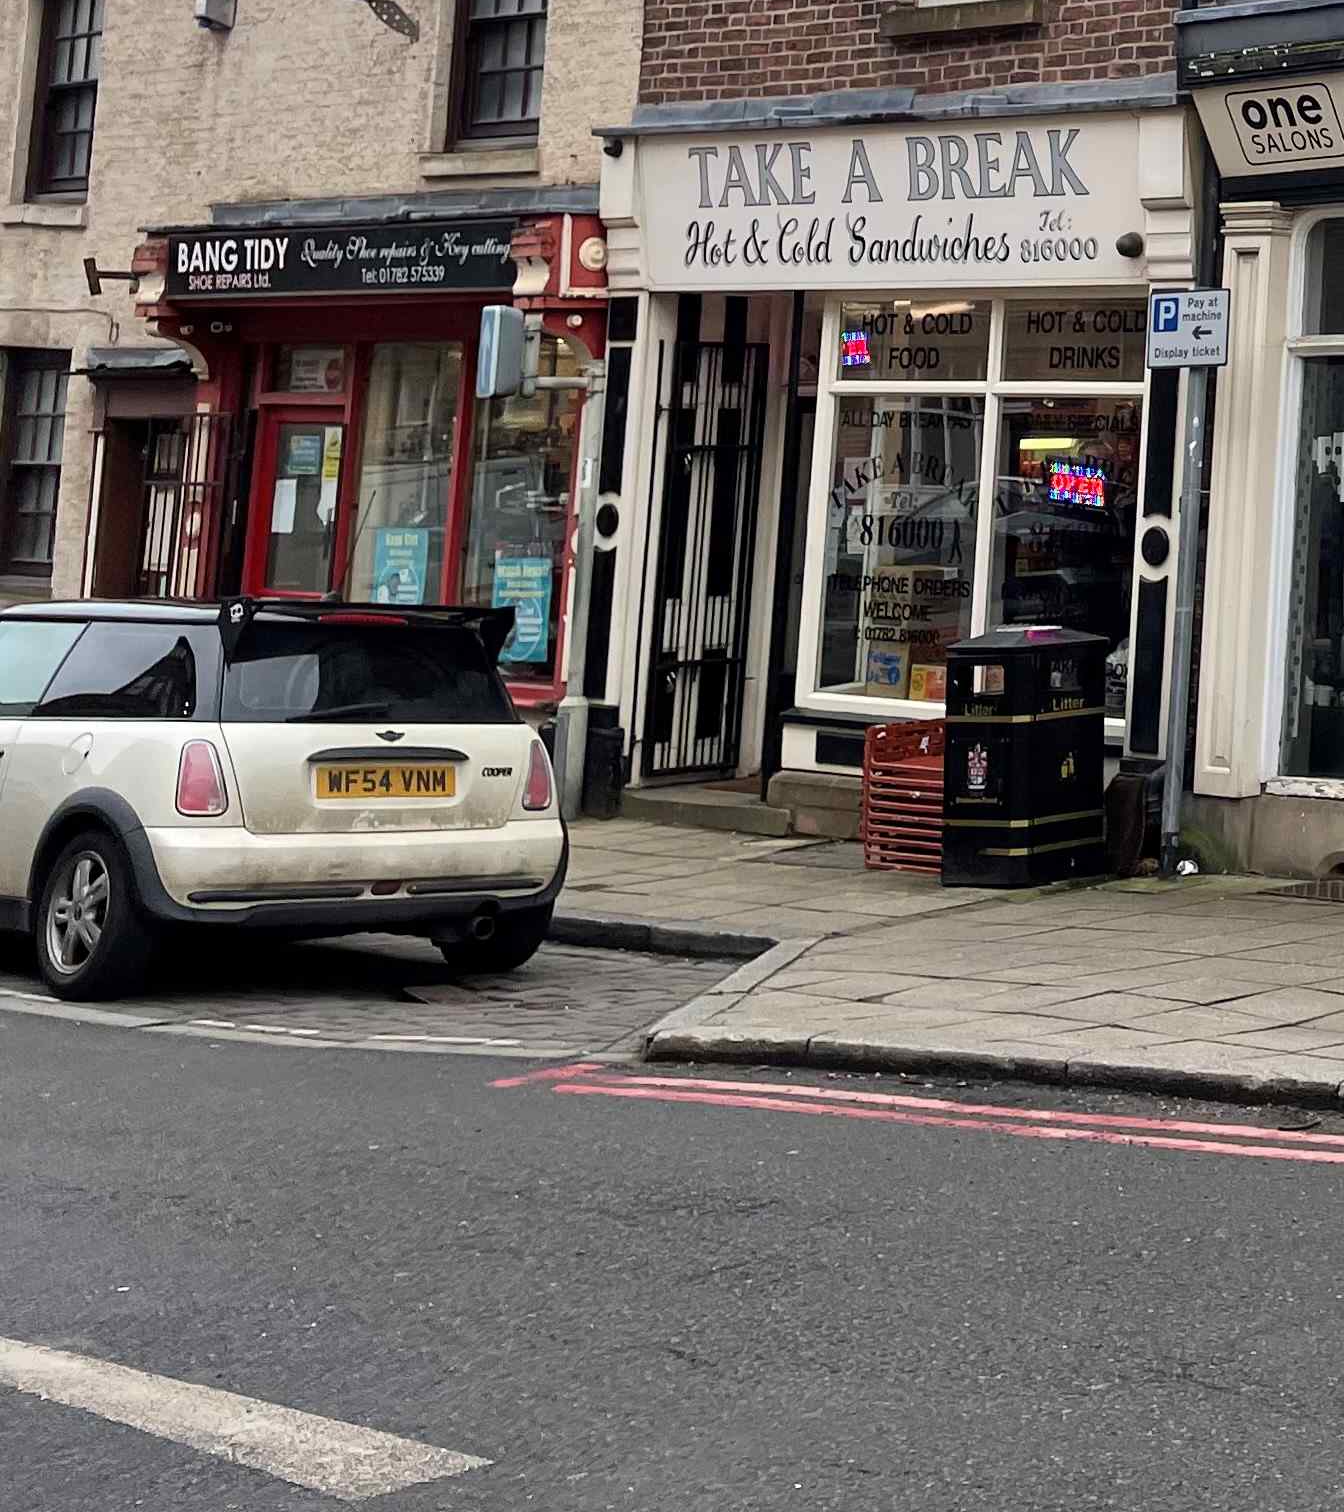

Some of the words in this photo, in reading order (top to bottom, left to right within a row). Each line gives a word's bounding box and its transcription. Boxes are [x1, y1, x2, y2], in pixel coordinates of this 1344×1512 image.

[1241, 93, 1324, 131] one
[1251, 126, 1334, 155] SALONS
[688, 141, 817, 208] TAKE
[841, 138, 884, 204] A
[905, 128, 1091, 202] BREAK
[1038, 209, 1073, 232] Tel:
[301, 238, 343, 268] Quality
[379, 241, 417, 265] repairs
[435, 232, 469, 264] Key
[683, 220, 738, 267] Hot
[743, 217, 769, 265] &
[777, 212, 836, 265] Cold
[845, 212, 1011, 265] Sandwiches
[1018, 237, 1099, 264] 816000
[177, 239, 239, 273] BANG
[244, 237, 289, 271] TIDY
[188, 274, 214, 290] SHOE
[215, 273, 251, 290] REPAIRS
[378, 266, 409, 283] 01782
[409, 265, 446, 282] 575339
[1187, 297, 1205, 309] Pay
[1208, 296, 1219, 307] at
[862, 313, 898, 335] HOT
[903, 313, 915, 335] &
[921, 311, 973, 335] COLD
[1026, 311, 1064, 334] HOT
[1071, 311, 1086, 334] &
[1092, 310, 1146, 333] COLD
[1182, 310, 1222, 321] machine
[887, 346, 941, 370] FOOD
[1049, 345, 1121, 369] DRINKS
[1154, 347, 1189, 360] Display
[1192, 345, 1220, 357] ticket
[840, 410, 862, 428] ALL
[870, 410, 894, 429] DAY
[1051, 474, 1104, 495] OPEN
[860, 514, 945, 550] 816000
[913, 577, 971, 599] ORDERS
[863, 599, 932, 622] WELCOME
[963, 703, 994, 717] Litter
[1052, 697, 1085, 712] Litter
[327, 769, 393, 793] WF54
[399, 769, 447, 793] VNM
[481, 767, 513, 778] COOPER
